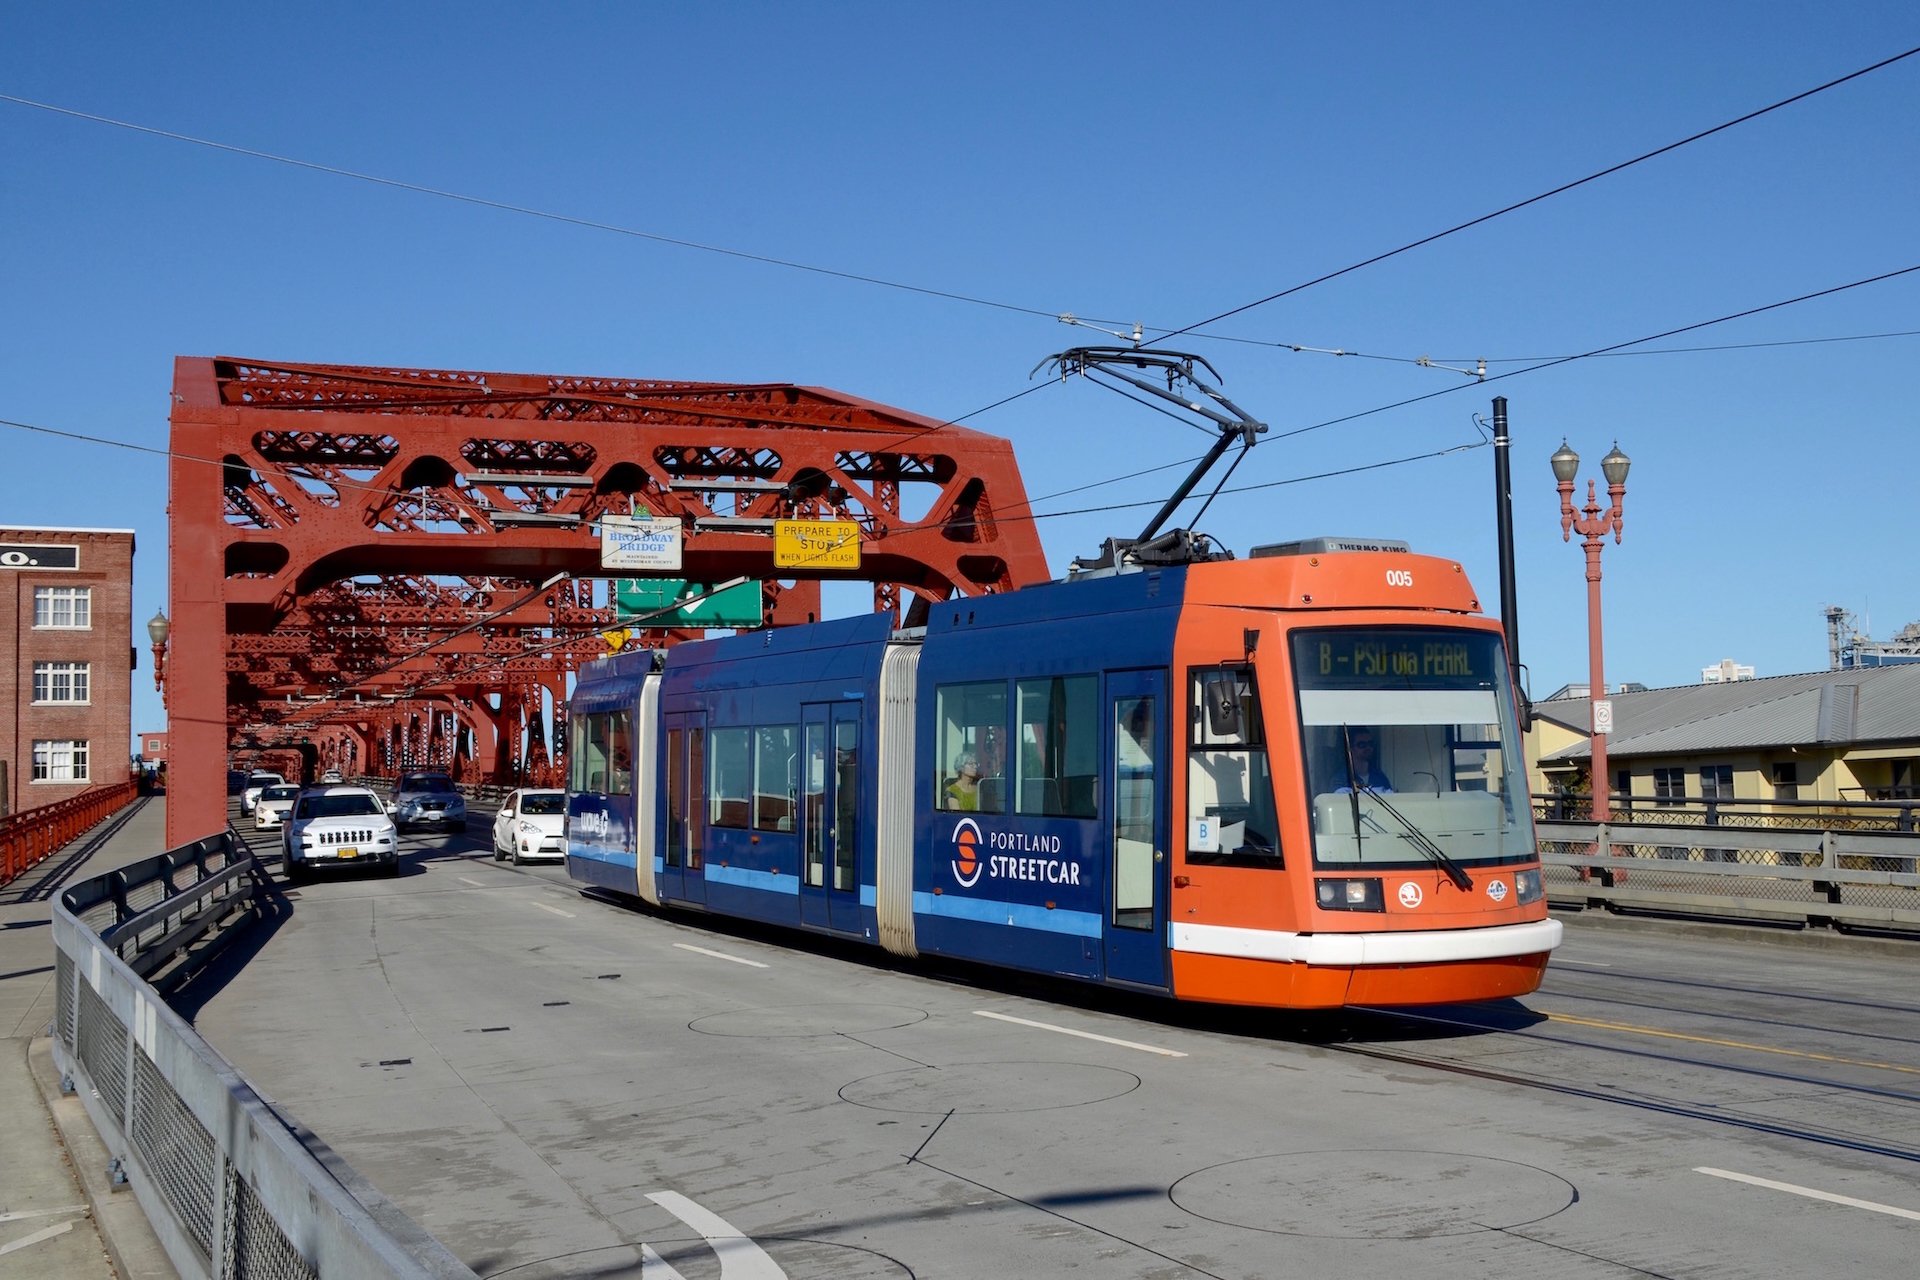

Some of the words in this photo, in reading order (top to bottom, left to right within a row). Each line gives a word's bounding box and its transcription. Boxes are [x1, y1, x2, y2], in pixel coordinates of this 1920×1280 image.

[610, 532, 674, 542] BROADWAY
[784, 526, 832, 536] PREPARE
[838, 527, 850, 536] TO
[620, 543, 665, 552] BRIDGE
[1338, 543, 1379, 552] THERMO
[1382, 545, 1407, 553] KING
[780, 553, 800, 561] WHEN
[804, 553, 828, 562] LIGHTS
[831, 554, 854, 562] FLASH
[1386, 570, 1413, 587] 005
[1319, 642, 1331, 675] B
[1354, 642, 1387, 675] PSU
[1423, 643, 1473, 675] PEARL
[1200, 823, 1208, 838] B
[990, 832, 1061, 853] PORTLAND
[989, 855, 1080, 886] STREETCAR
